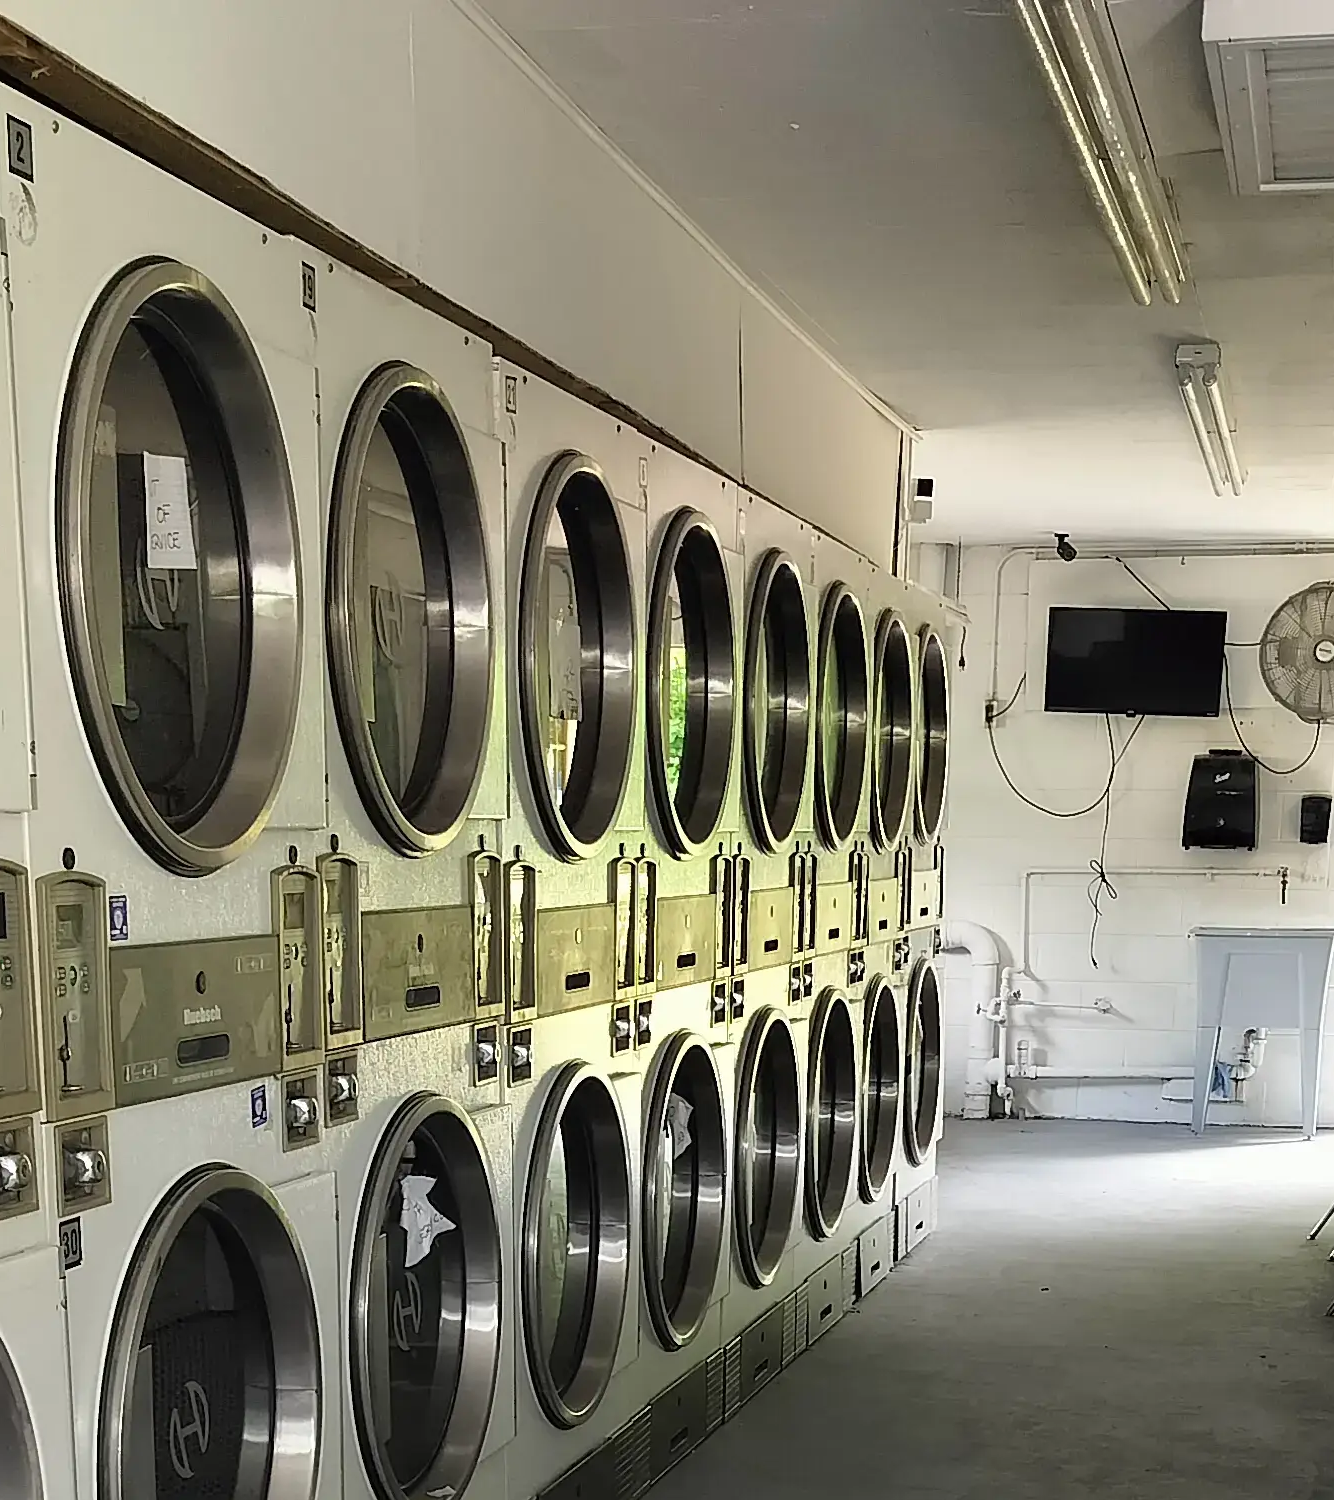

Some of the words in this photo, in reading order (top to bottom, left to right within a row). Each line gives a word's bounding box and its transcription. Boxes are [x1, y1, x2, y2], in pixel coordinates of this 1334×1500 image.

[15, 130, 26, 165] 2
[301, 271, 313, 300] 19
[62, 1228, 78, 1260] 30
